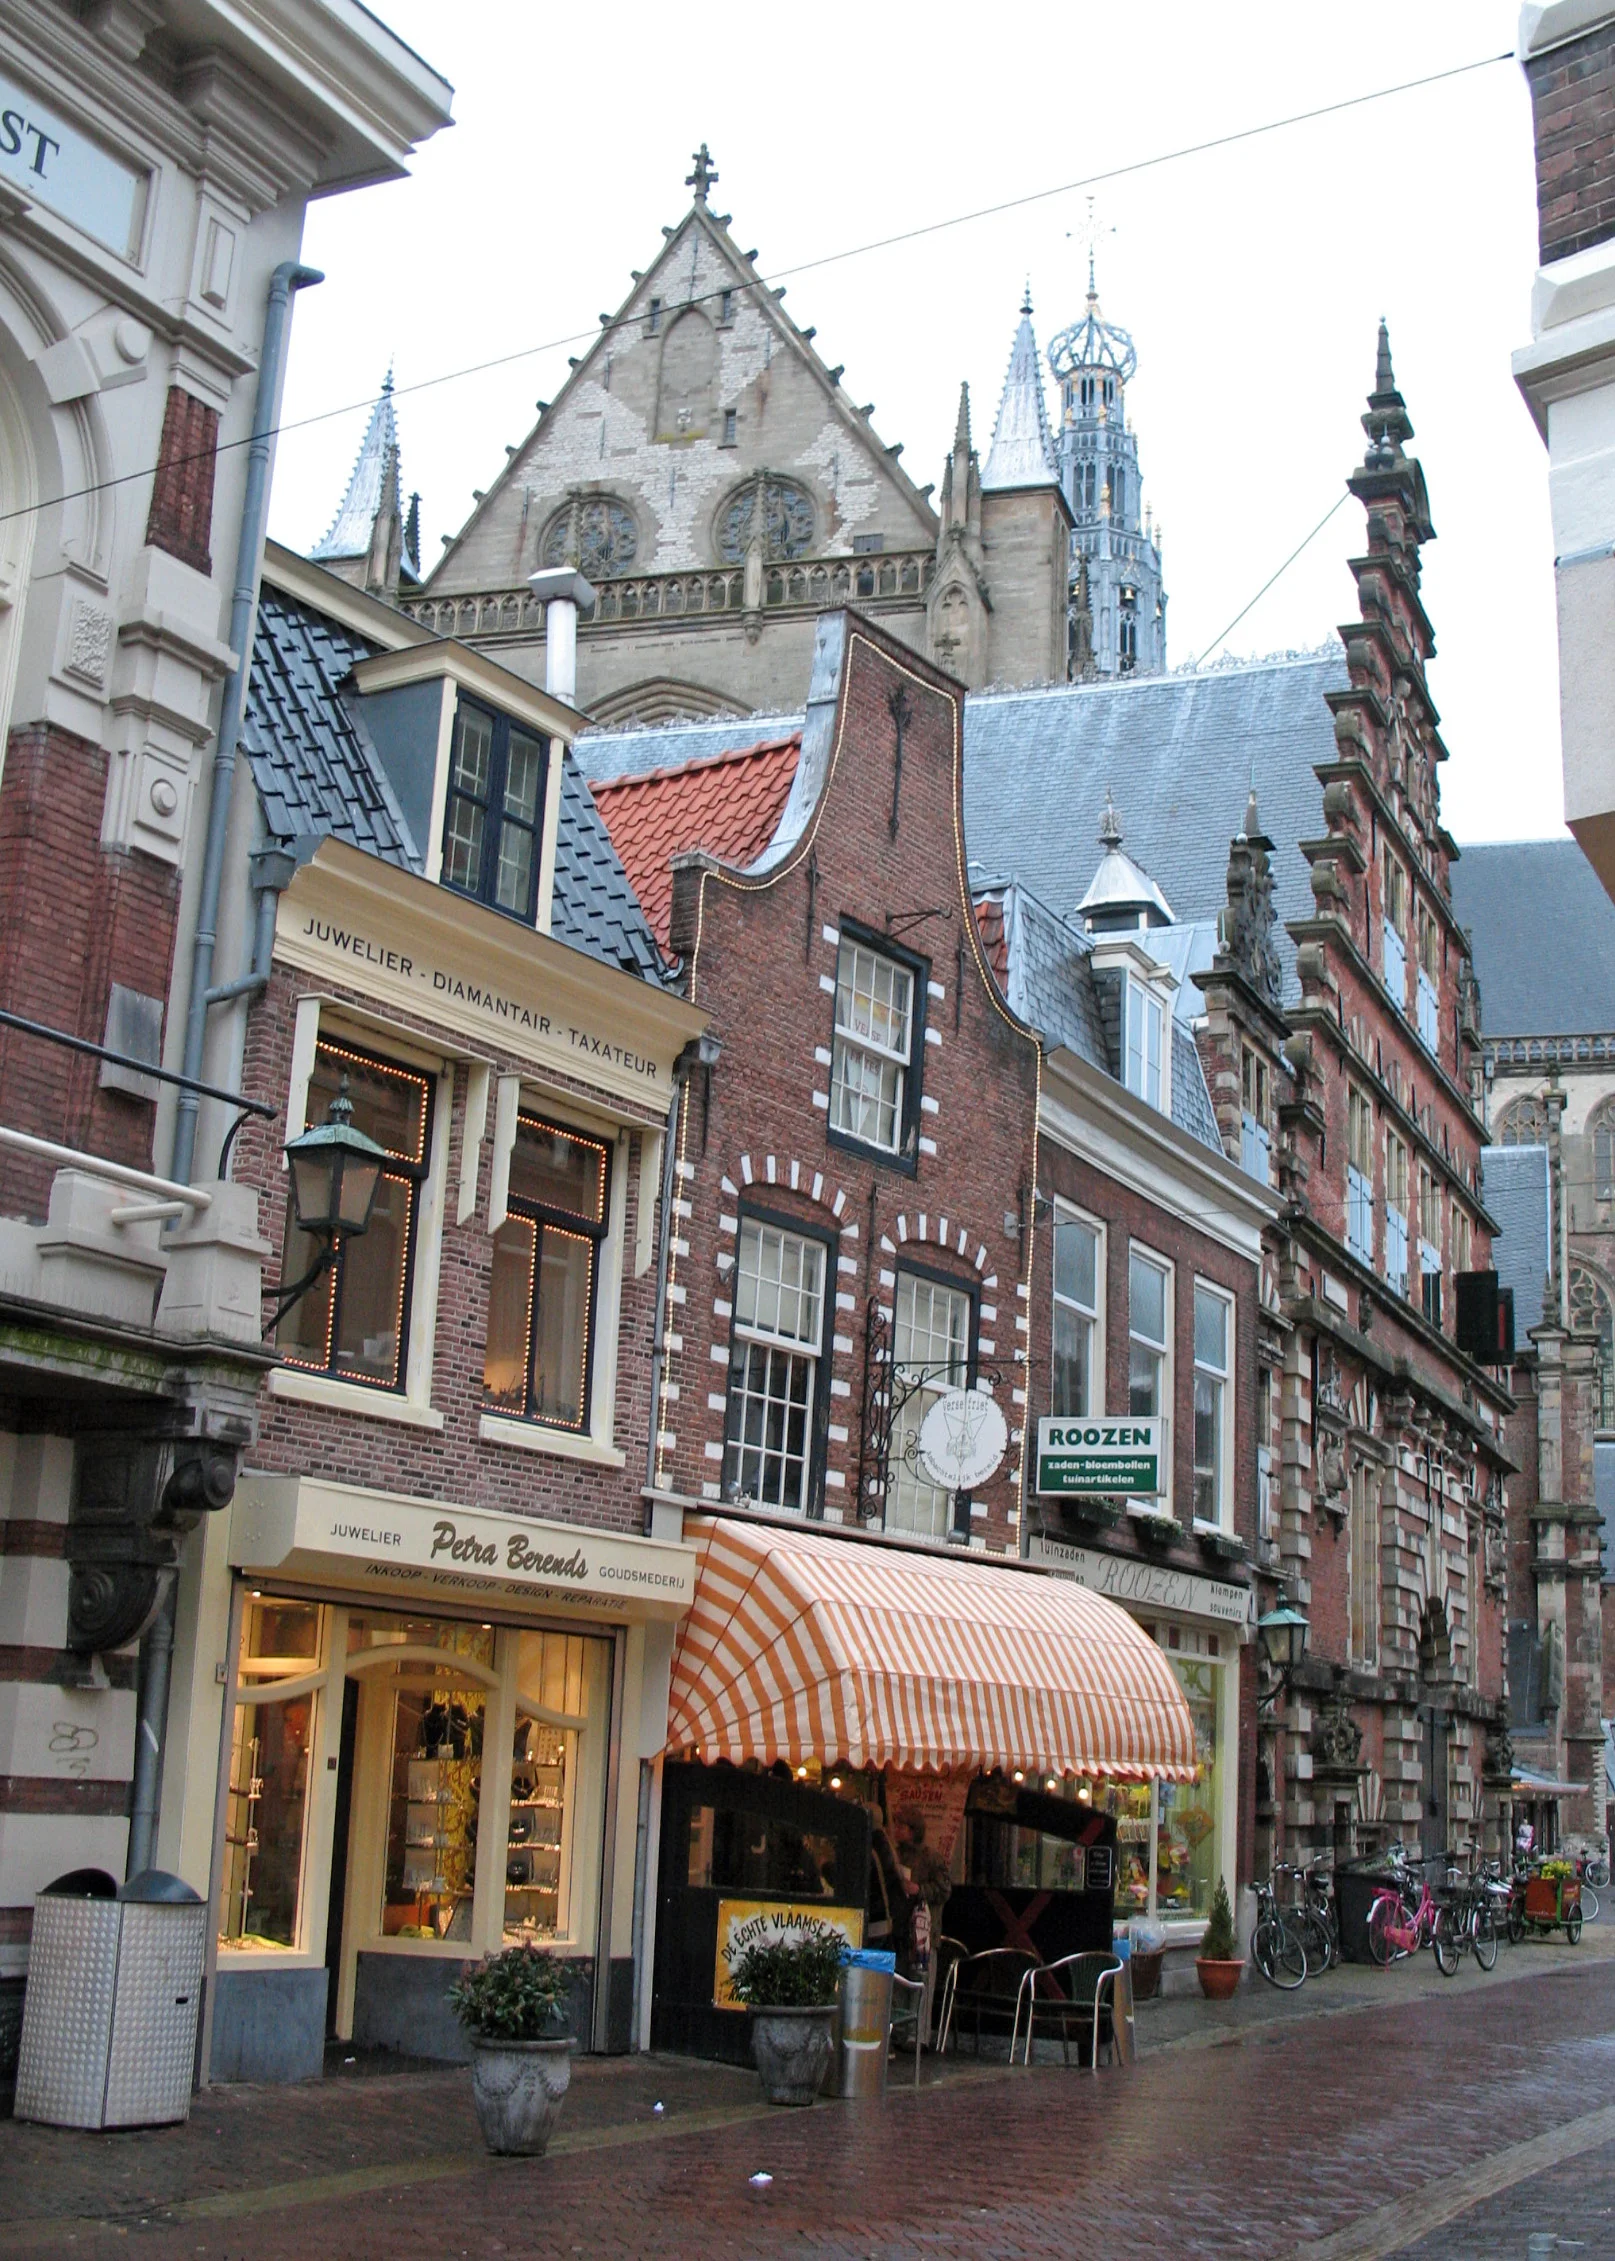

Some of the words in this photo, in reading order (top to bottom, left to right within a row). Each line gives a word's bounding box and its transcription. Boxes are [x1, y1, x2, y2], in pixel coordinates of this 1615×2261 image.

[303, 918, 412, 978] JUWELIER
[433, 972, 551, 1035] DIAMANTAIR
[568, 1028, 657, 1079] TAXATEUR
[1048, 1427, 1151, 1447] ROOZEN
[1062, 1474, 1135, 1484] tuinartikelen
[330, 1522, 401, 1546] JUWELIER
[430, 1520, 499, 1566] Petra
[507, 1534, 589, 1580] Berends
[599, 1566, 685, 1589] GOUDSMEDERIJ
[364, 1563, 422, 1580] INKOOP
[433, 1574, 497, 1590] VERKOOP
[504, 1584, 553, 1599] DESIGN
[561, 1592, 627, 1610] REPARATIE
[1093, 1555, 1205, 1609] ROOZEN
[1210, 1582, 1243, 1600] klompen
[1209, 1603, 1242, 1619] souvenirs
[721, 1942, 737, 1963] DE
[771, 1911, 826, 1936] VLAAMSE
